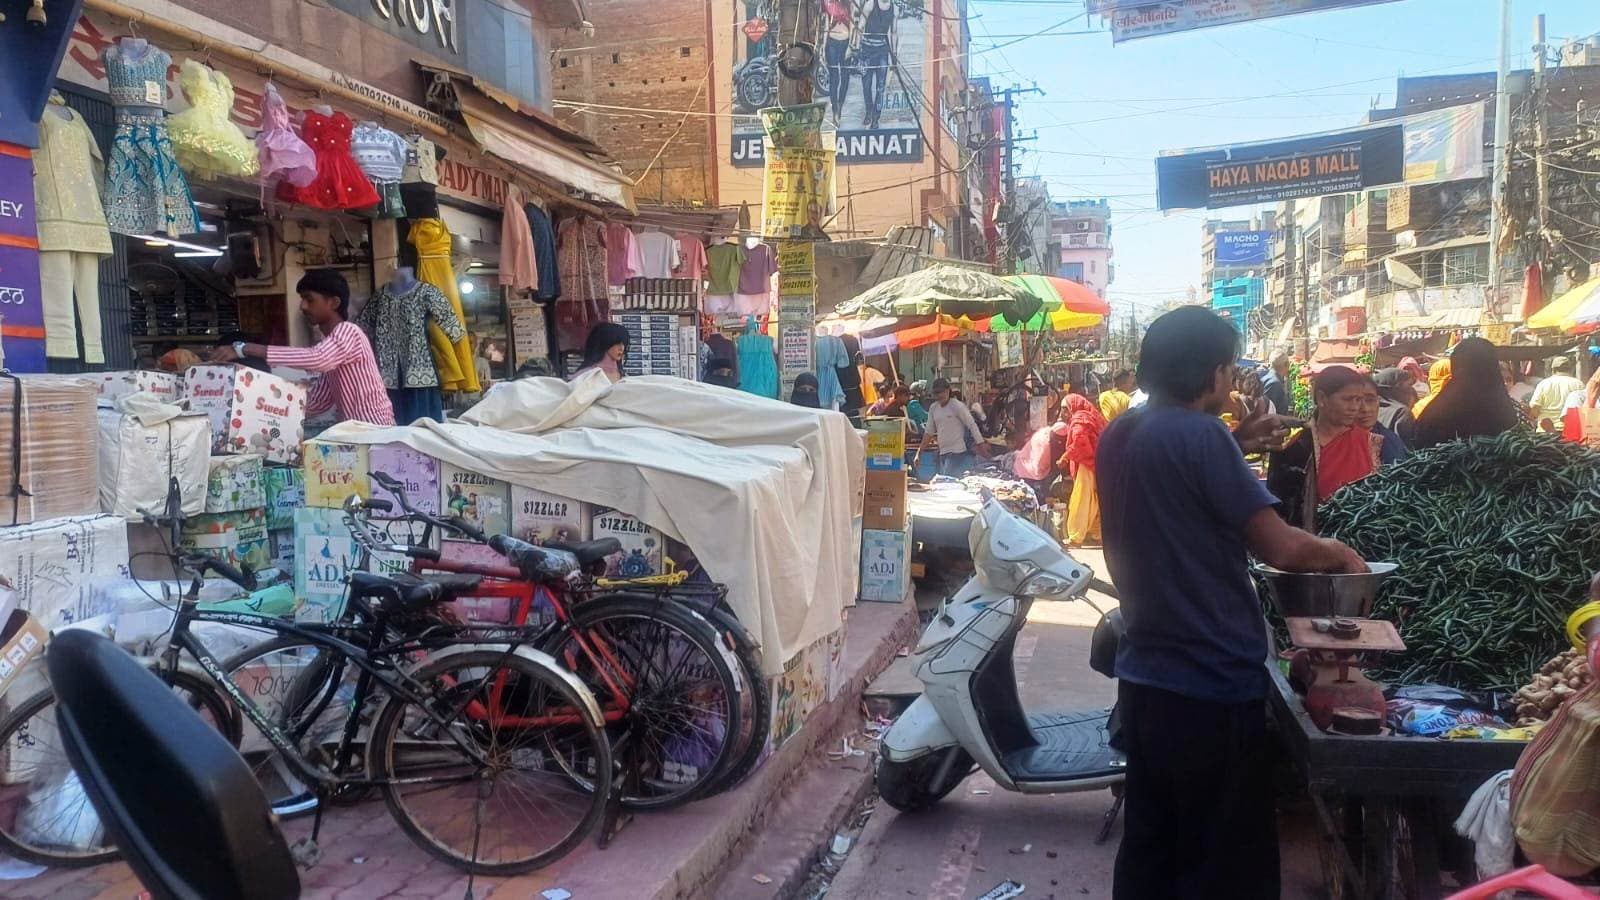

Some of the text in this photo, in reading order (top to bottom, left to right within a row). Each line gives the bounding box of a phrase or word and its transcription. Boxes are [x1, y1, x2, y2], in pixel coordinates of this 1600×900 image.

[733, 138, 767, 160] JE
[1210, 152, 1360, 188] HAYA NAQAB MALL
[0, 200, 23, 218] EY
[1224, 234, 1260, 244] MACHO
[192, 384, 225, 397] Sweet
[256, 396, 289, 418] Sweet
[523, 500, 568, 517] SIZZLER
